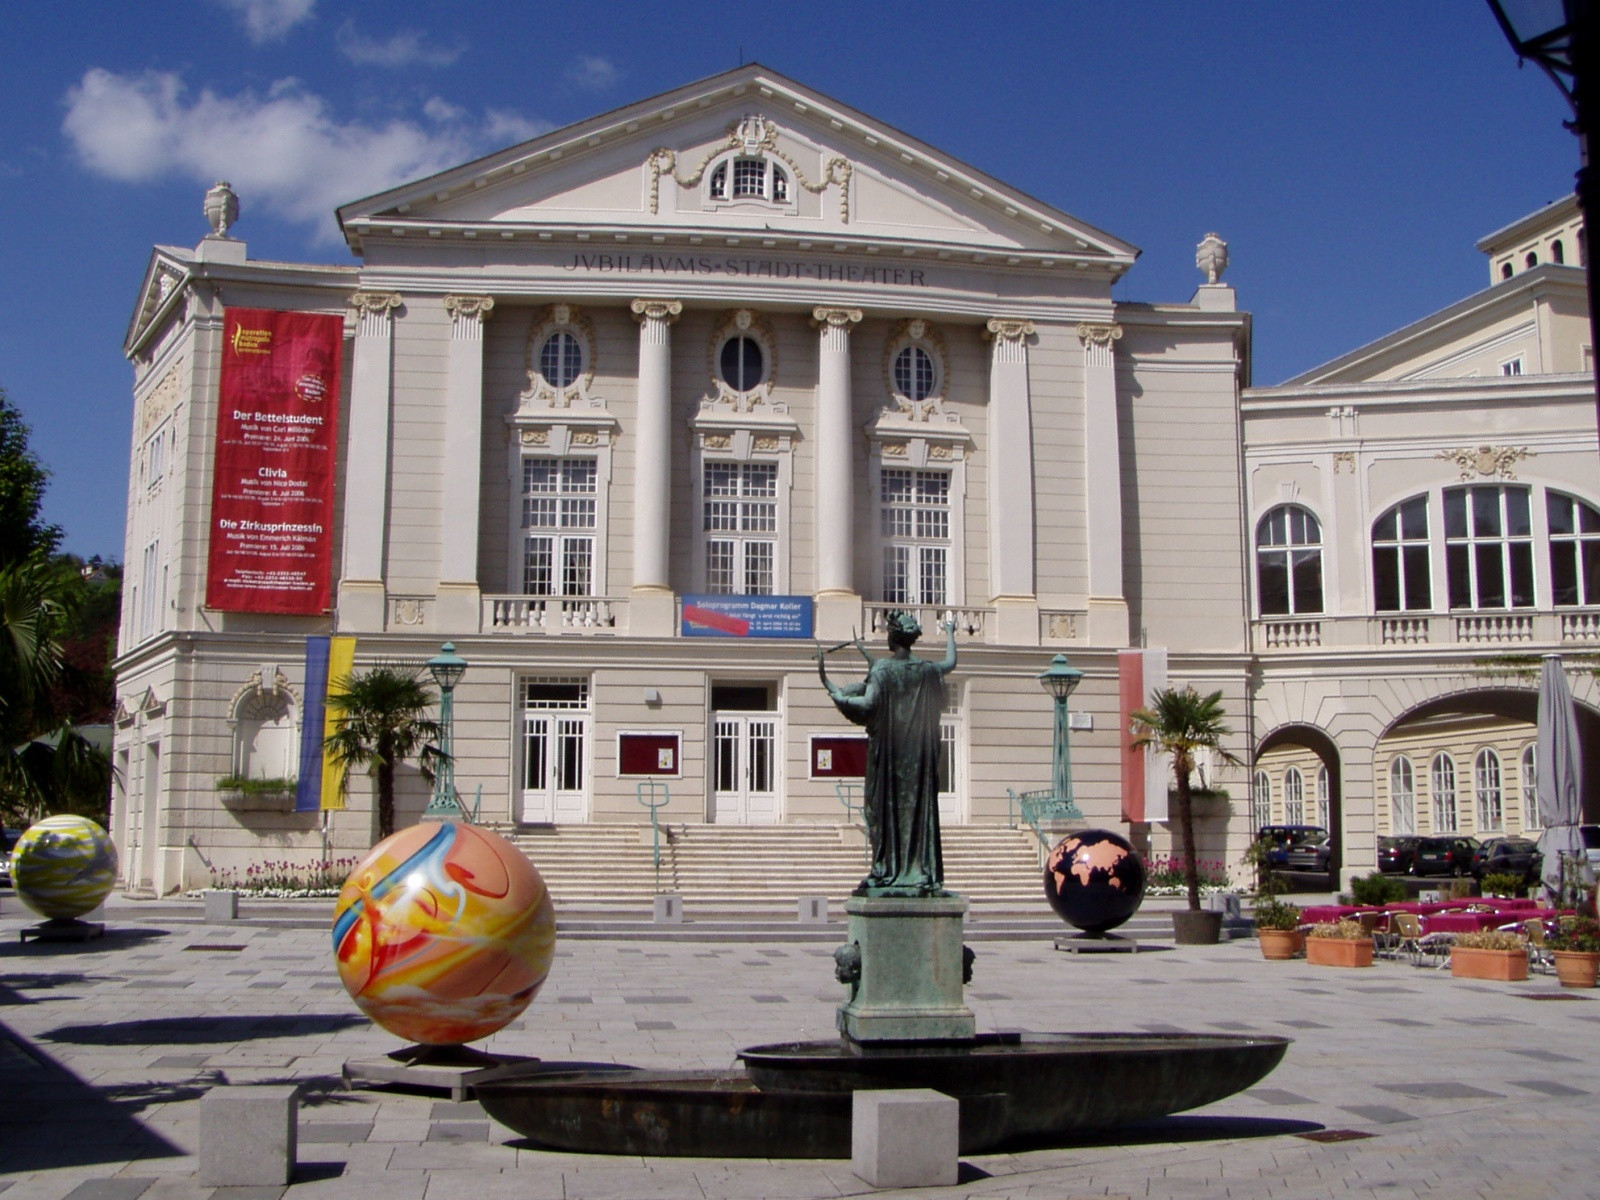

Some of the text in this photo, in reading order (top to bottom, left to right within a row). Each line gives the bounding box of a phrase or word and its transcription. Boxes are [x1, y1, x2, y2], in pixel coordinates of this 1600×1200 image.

[233, 410, 323, 425] Der Bettelstudent
[241, 423, 259, 431] Musik
[273, 425, 286, 433] Carl
[258, 467, 288, 478] Clivia
[241, 478, 259, 486] Musik
[219, 519, 323, 534] Die Zirkusprinzessin
[226, 532, 245, 540] Musik
[696, 601, 749, 610] Soloprogramm
[750, 602, 777, 611] Dagmar
